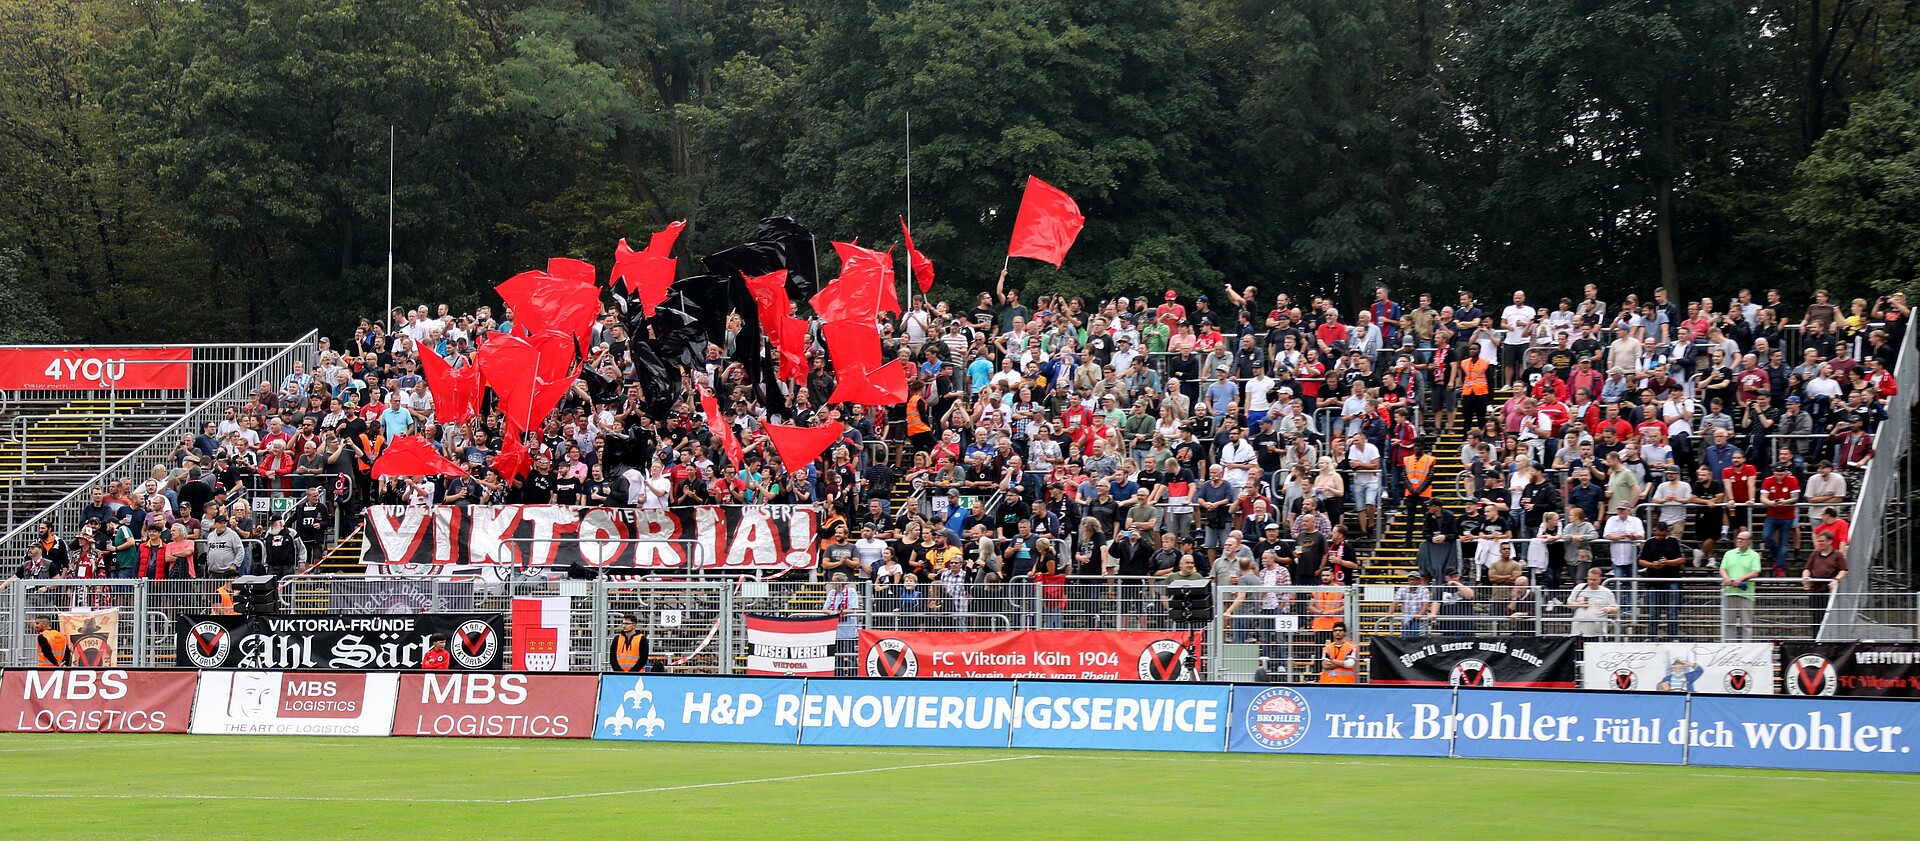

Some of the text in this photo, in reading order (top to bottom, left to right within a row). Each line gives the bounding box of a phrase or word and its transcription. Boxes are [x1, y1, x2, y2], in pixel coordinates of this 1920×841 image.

[44, 358, 126, 381] 4YOU
[256, 501, 266, 509] 32
[935, 500, 946, 509] 33
[366, 504, 816, 568] VIKTORIA!
[199, 625, 218, 633] 1904
[268, 616, 415, 632] VIKTORIA-FRÜNDE
[665, 614, 677, 624] 38
[1279, 620, 1293, 629] 39
[189, 643, 217, 666] VIKTORIA
[238, 633, 317, 669] Ahl
[454, 643, 483, 666] VIKTORIA
[753, 643, 828, 659] UNSER VEREIN
[932, 650, 1119, 667] FC Viktoria Köln 1904
[1440, 640, 1475, 653] never
[1478, 641, 1508, 654] walk
[1510, 648, 1544, 668] alone
[772, 661, 808, 669] VIKTORIA
[23, 670, 128, 700] MBS
[286, 680, 337, 697] MBS
[421, 673, 529, 705] MBS
[284, 700, 356, 712] LOGISTICS
[1251, 689, 1307, 713] QUELLEN DES
[17, 709, 167, 731] LOGISTICS
[682, 692, 1219, 733] H&P RENOVIERUNGSSERVICE
[1256, 713, 1302, 723] BROHLER
[223, 723, 360, 734] THE ART OF LOGISTICS
[416, 714, 570, 736] LOGISTICS
[1250, 724, 1306, 747] WOHLSEINS
[1325, 701, 1911, 754] Trink Brohler. Fühl dich wohler.
